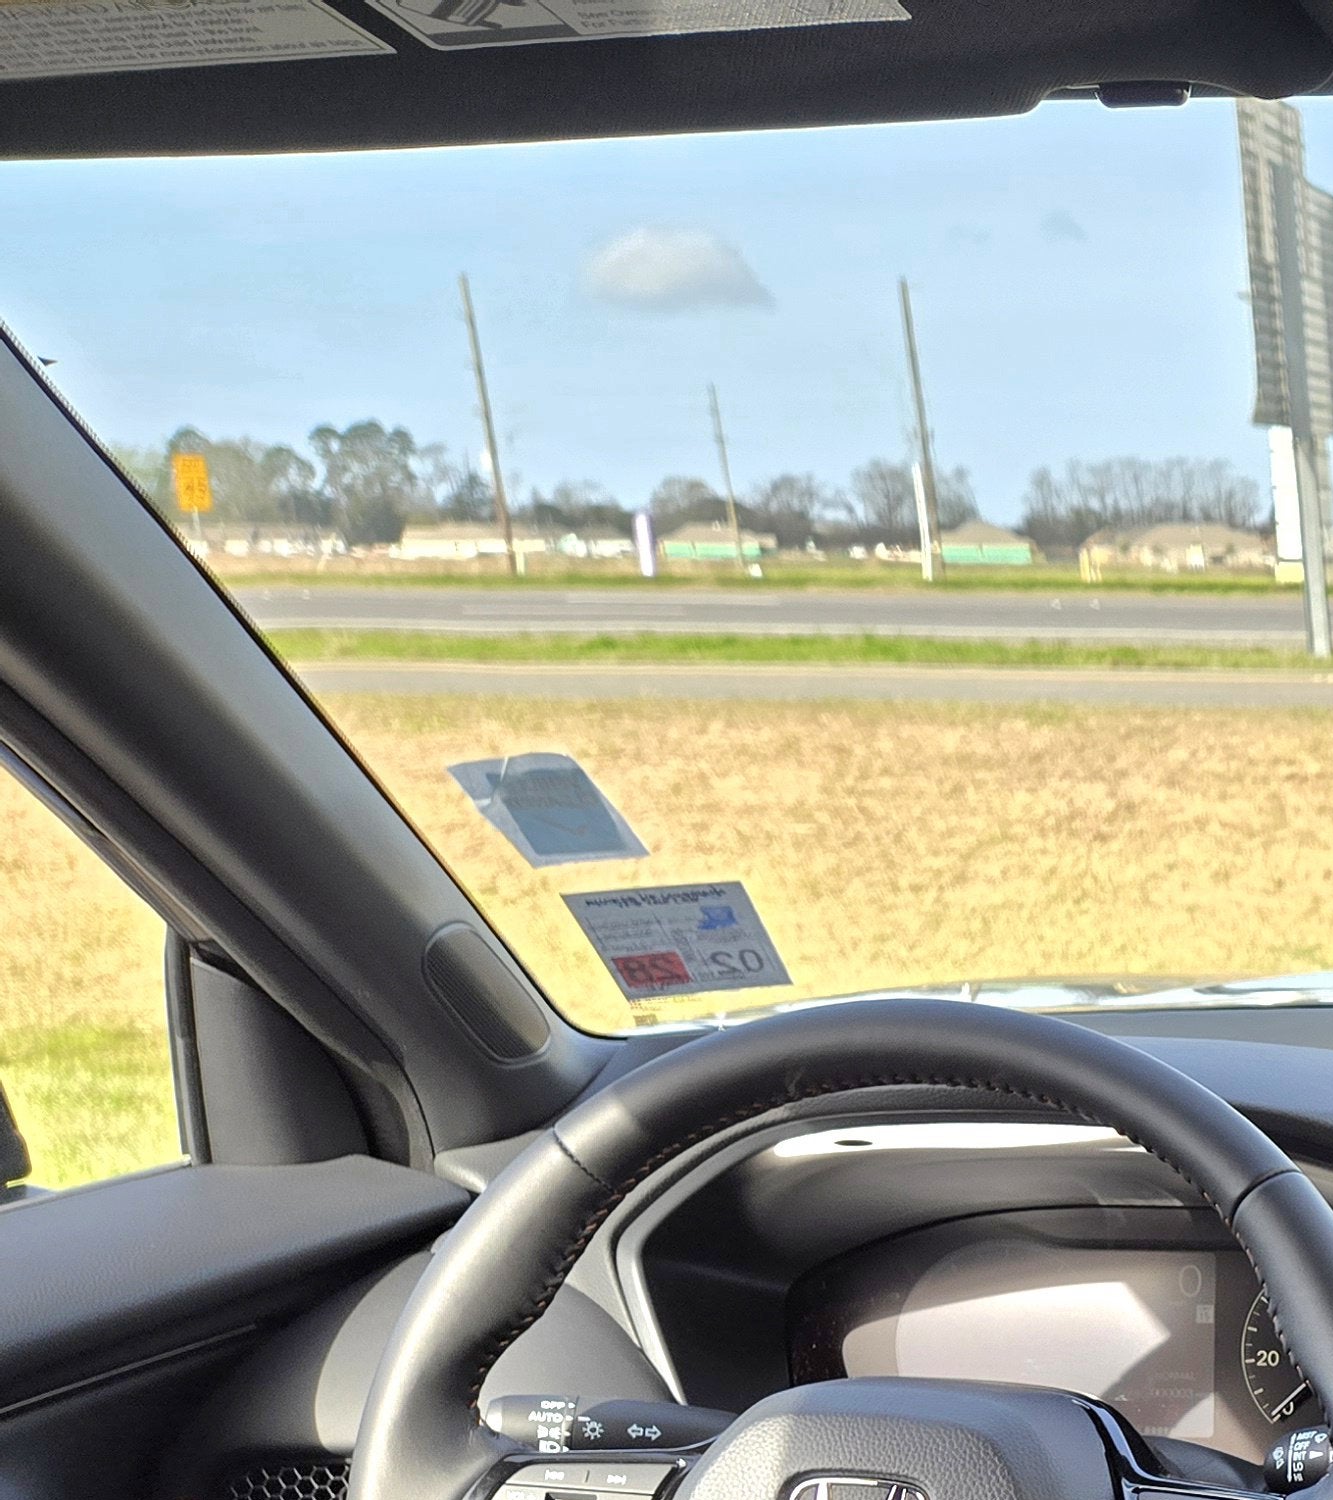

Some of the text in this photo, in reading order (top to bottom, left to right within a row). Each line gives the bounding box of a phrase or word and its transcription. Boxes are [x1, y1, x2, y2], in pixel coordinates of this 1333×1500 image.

[1256, 1350, 1280, 1368] 20
[528, 1410, 564, 1423] AUTO
[1294, 1440, 1311, 1451] OFF
[1293, 1450, 1307, 1461] INT
[1293, 1461, 1304, 1472] LO
